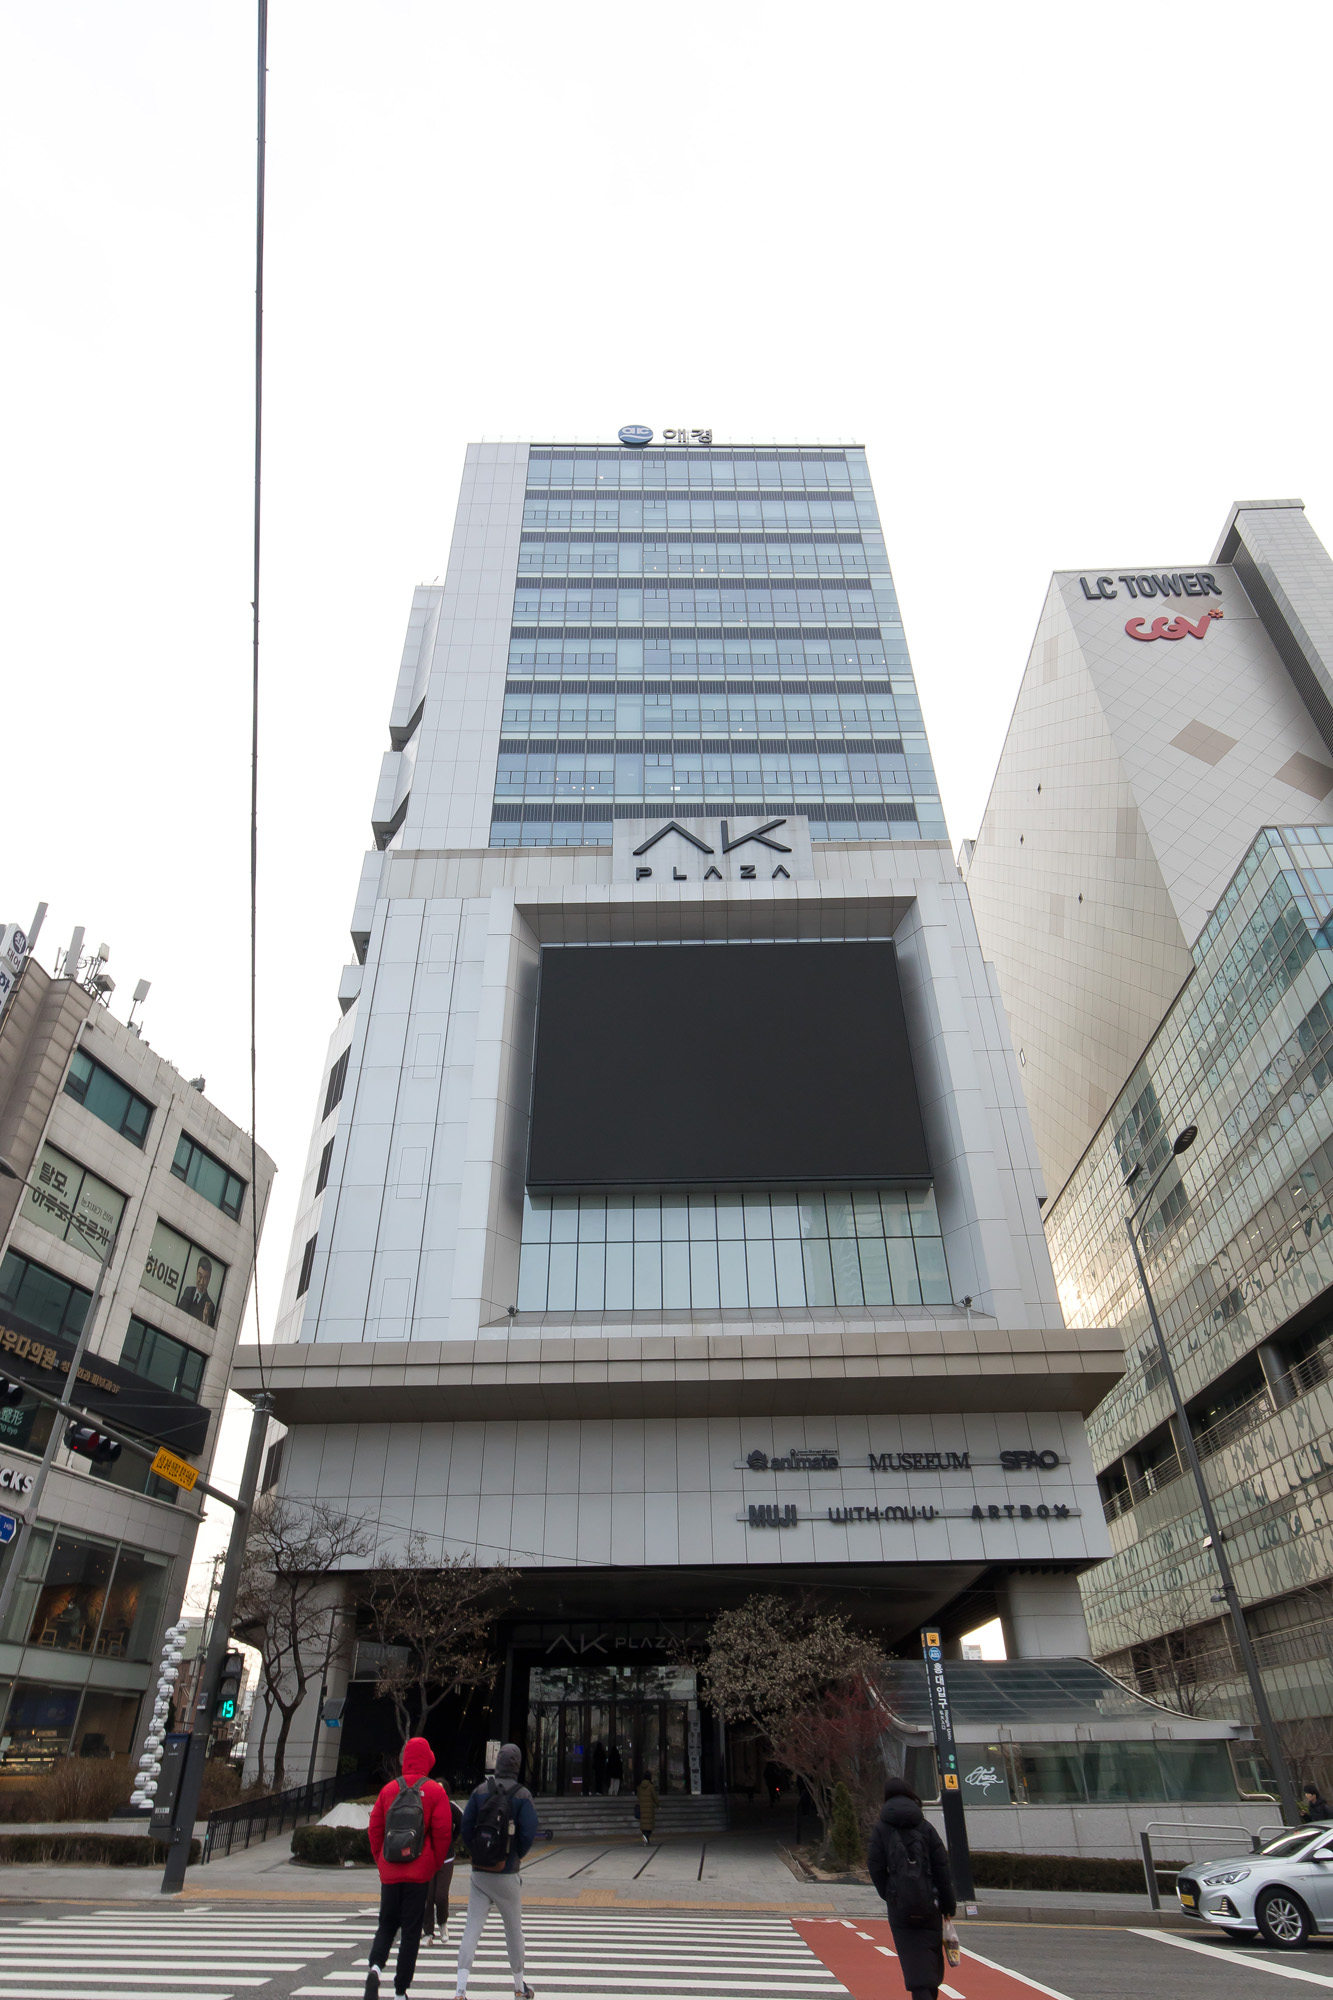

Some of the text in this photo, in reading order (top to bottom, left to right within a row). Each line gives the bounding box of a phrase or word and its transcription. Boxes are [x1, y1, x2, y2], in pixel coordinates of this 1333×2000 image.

[663, 428, 712, 444] 애경
[1079, 572, 1222, 600] LC TOWER
[1125, 616, 1212, 642] CGV
[632, 818, 792, 856] AK
[635, 864, 791, 881] PLAZA
[145, 1254, 179, 1290] 하이모
[0, 1325, 57, 1371] 우다의원
[771, 1449, 839, 1471] animate
[1000, 1450, 1059, 1470] SPAO
[749, 1504, 797, 1527] MUJI
[545, 1633, 681, 1654] AK PLAZA
[933, 1662, 948, 1709] 홍대입구
[222, 1700, 234, 1718] 19
[948, 1775, 954, 1785] 4
